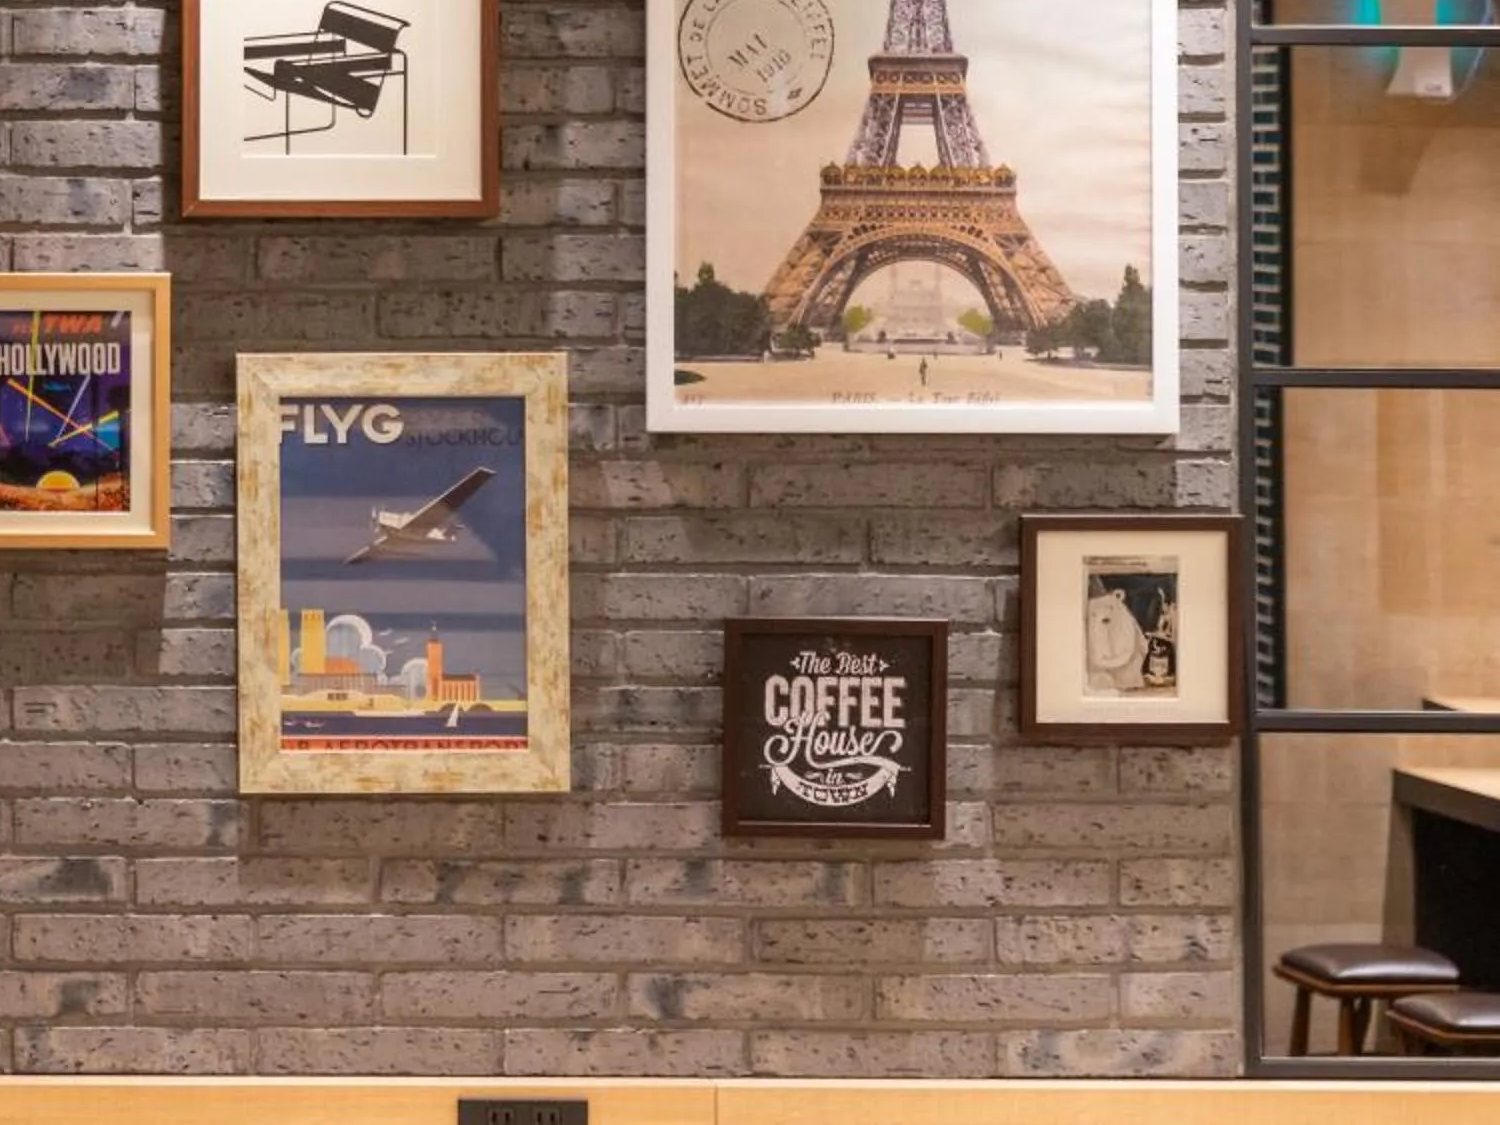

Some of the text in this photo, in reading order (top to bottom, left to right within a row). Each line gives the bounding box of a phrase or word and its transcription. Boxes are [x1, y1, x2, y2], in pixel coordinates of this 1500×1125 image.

[279, 404, 404, 444] FLYG
[800, 651, 878, 675] The Best
[765, 675, 907, 727] COFFEE
[763, 711, 903, 768] House
[825, 768, 845, 784] in
[798, 782, 870, 803] TOWN
